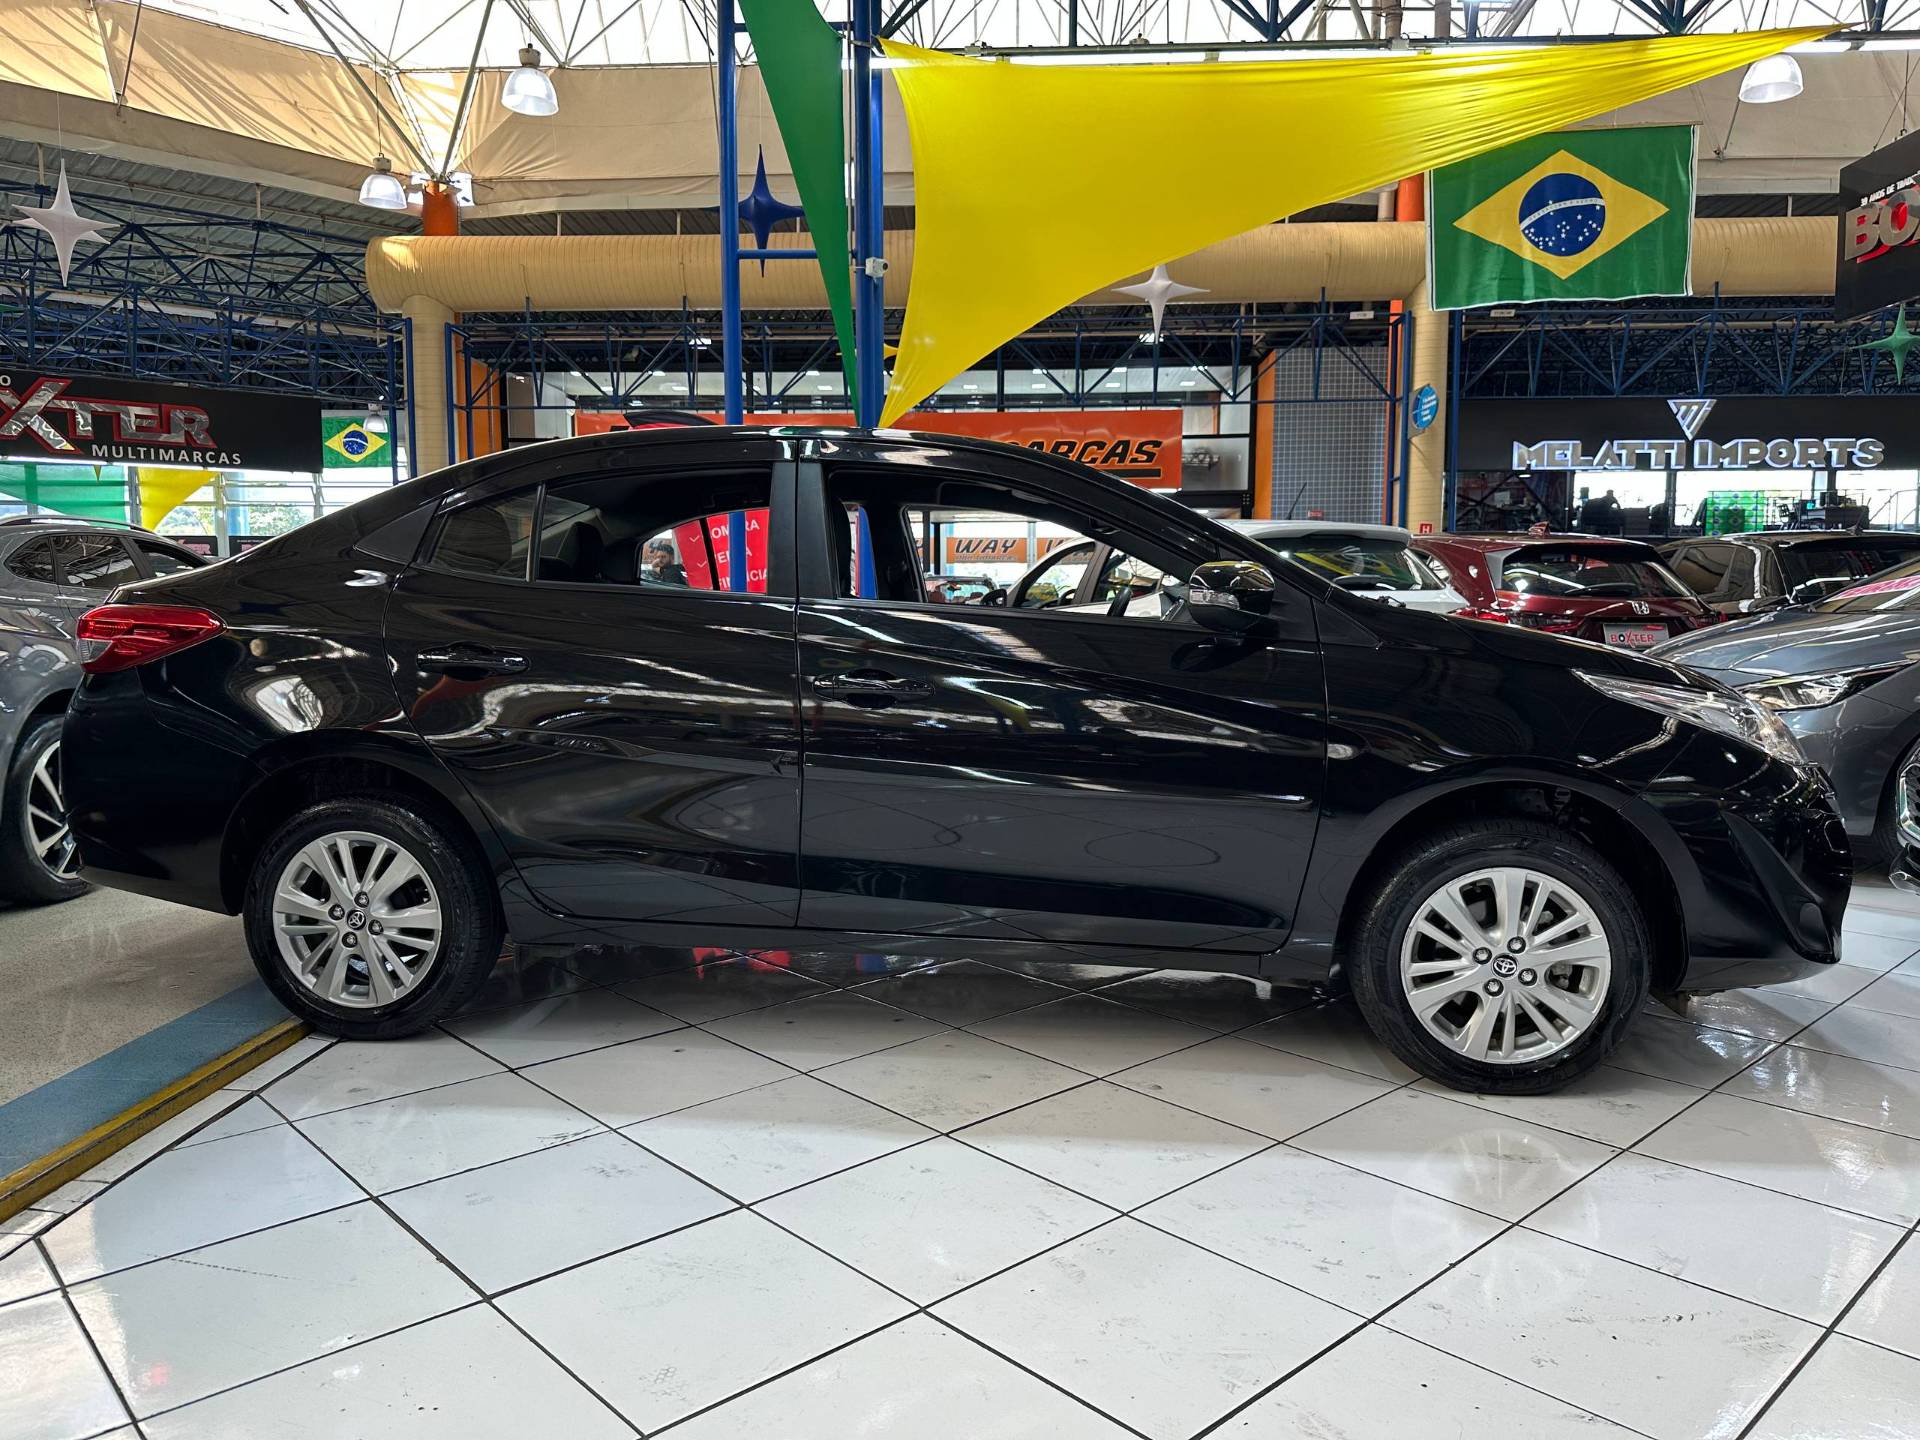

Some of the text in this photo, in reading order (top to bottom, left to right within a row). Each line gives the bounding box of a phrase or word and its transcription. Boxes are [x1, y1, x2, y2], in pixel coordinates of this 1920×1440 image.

[0, 376, 217, 454] XTER
[92, 444, 242, 465] MULTIMARCAS
[1512, 438, 1885, 470] MELATTI IMPORTS
[954, 538, 1017, 554] WAY
[1609, 629, 1655, 648] BOXTER
